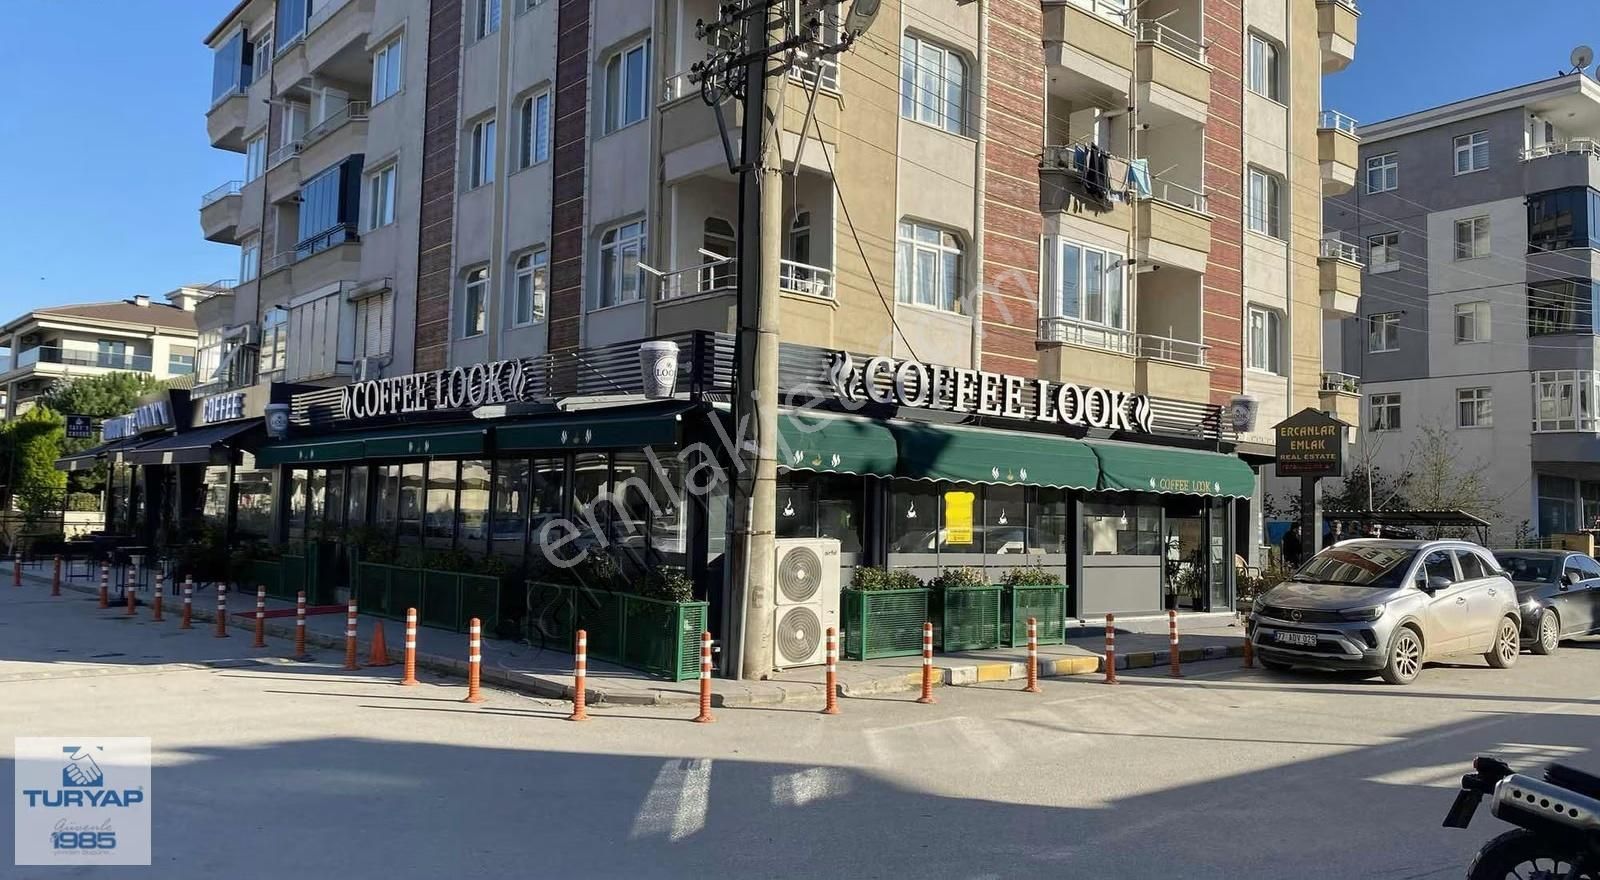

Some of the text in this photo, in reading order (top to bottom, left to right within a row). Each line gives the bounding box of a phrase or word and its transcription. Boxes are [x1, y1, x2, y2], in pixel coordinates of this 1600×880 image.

[352, 361, 509, 418] COFFEE LOOK
[864, 356, 1133, 431] COFFEE LOOK
[202, 392, 242, 423] COFFEE
[1280, 425, 1336, 437] ERCANLAR
[1290, 440, 1326, 450] EMLAK
[1159, 478, 1211, 492] COFFEE LOOK
